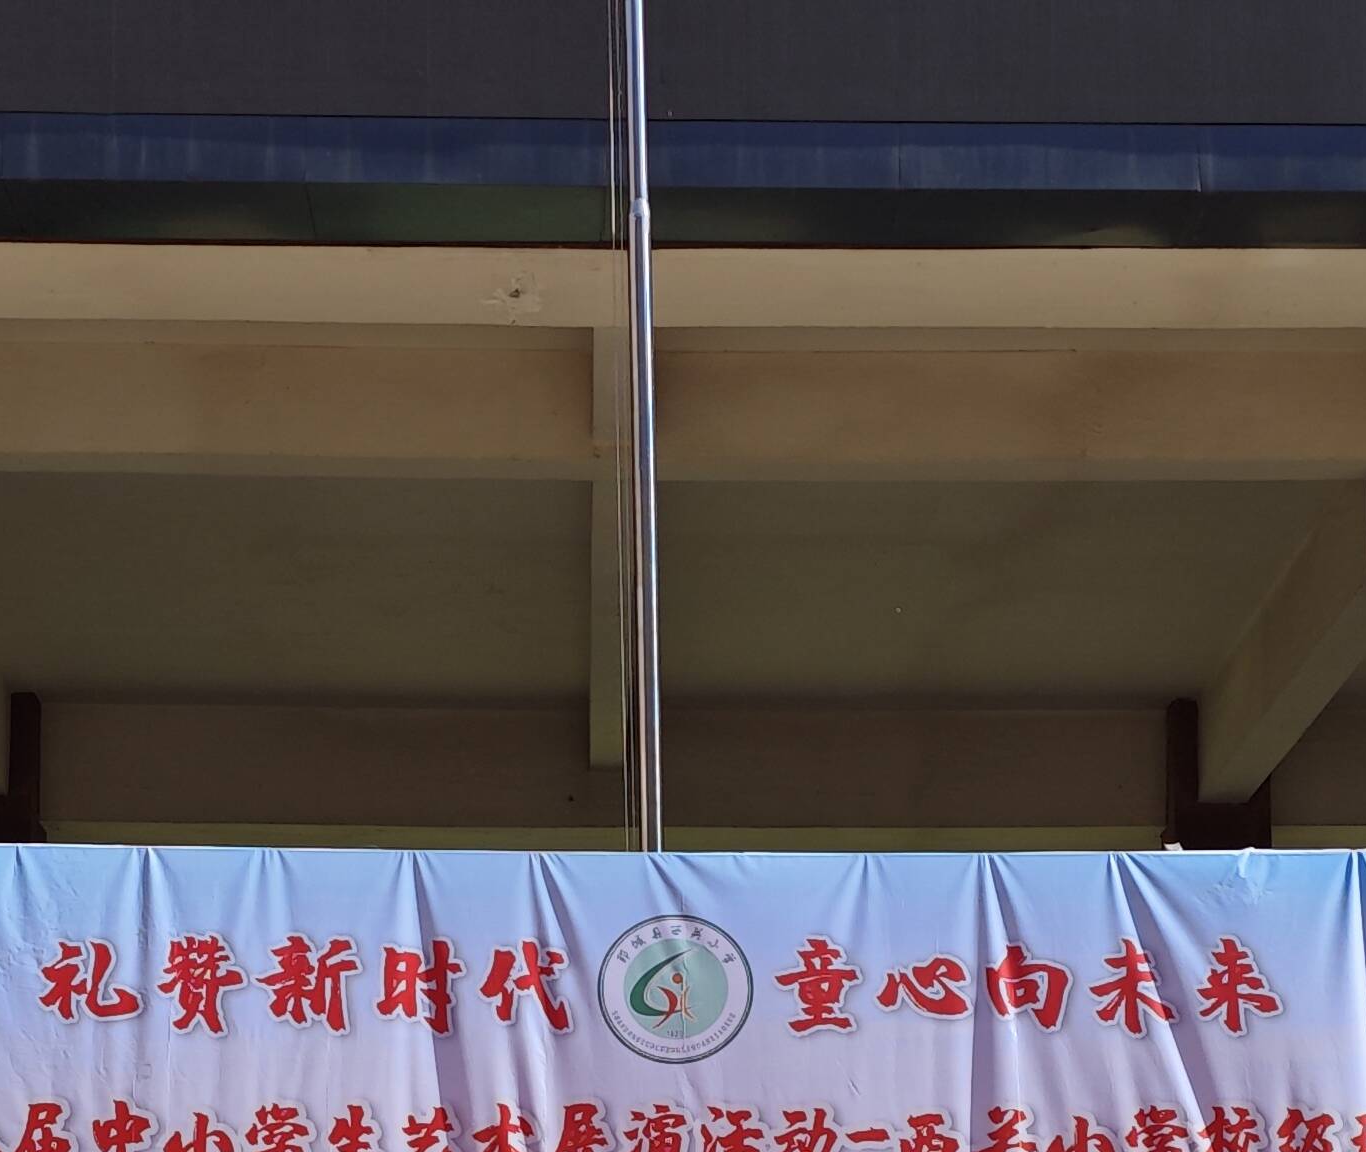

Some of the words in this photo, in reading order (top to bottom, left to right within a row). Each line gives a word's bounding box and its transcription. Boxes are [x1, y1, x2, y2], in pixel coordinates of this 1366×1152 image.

[39, 935, 569, 1033] 礼赞新时代
[775, 938, 1279, 1033] 童心向未来
